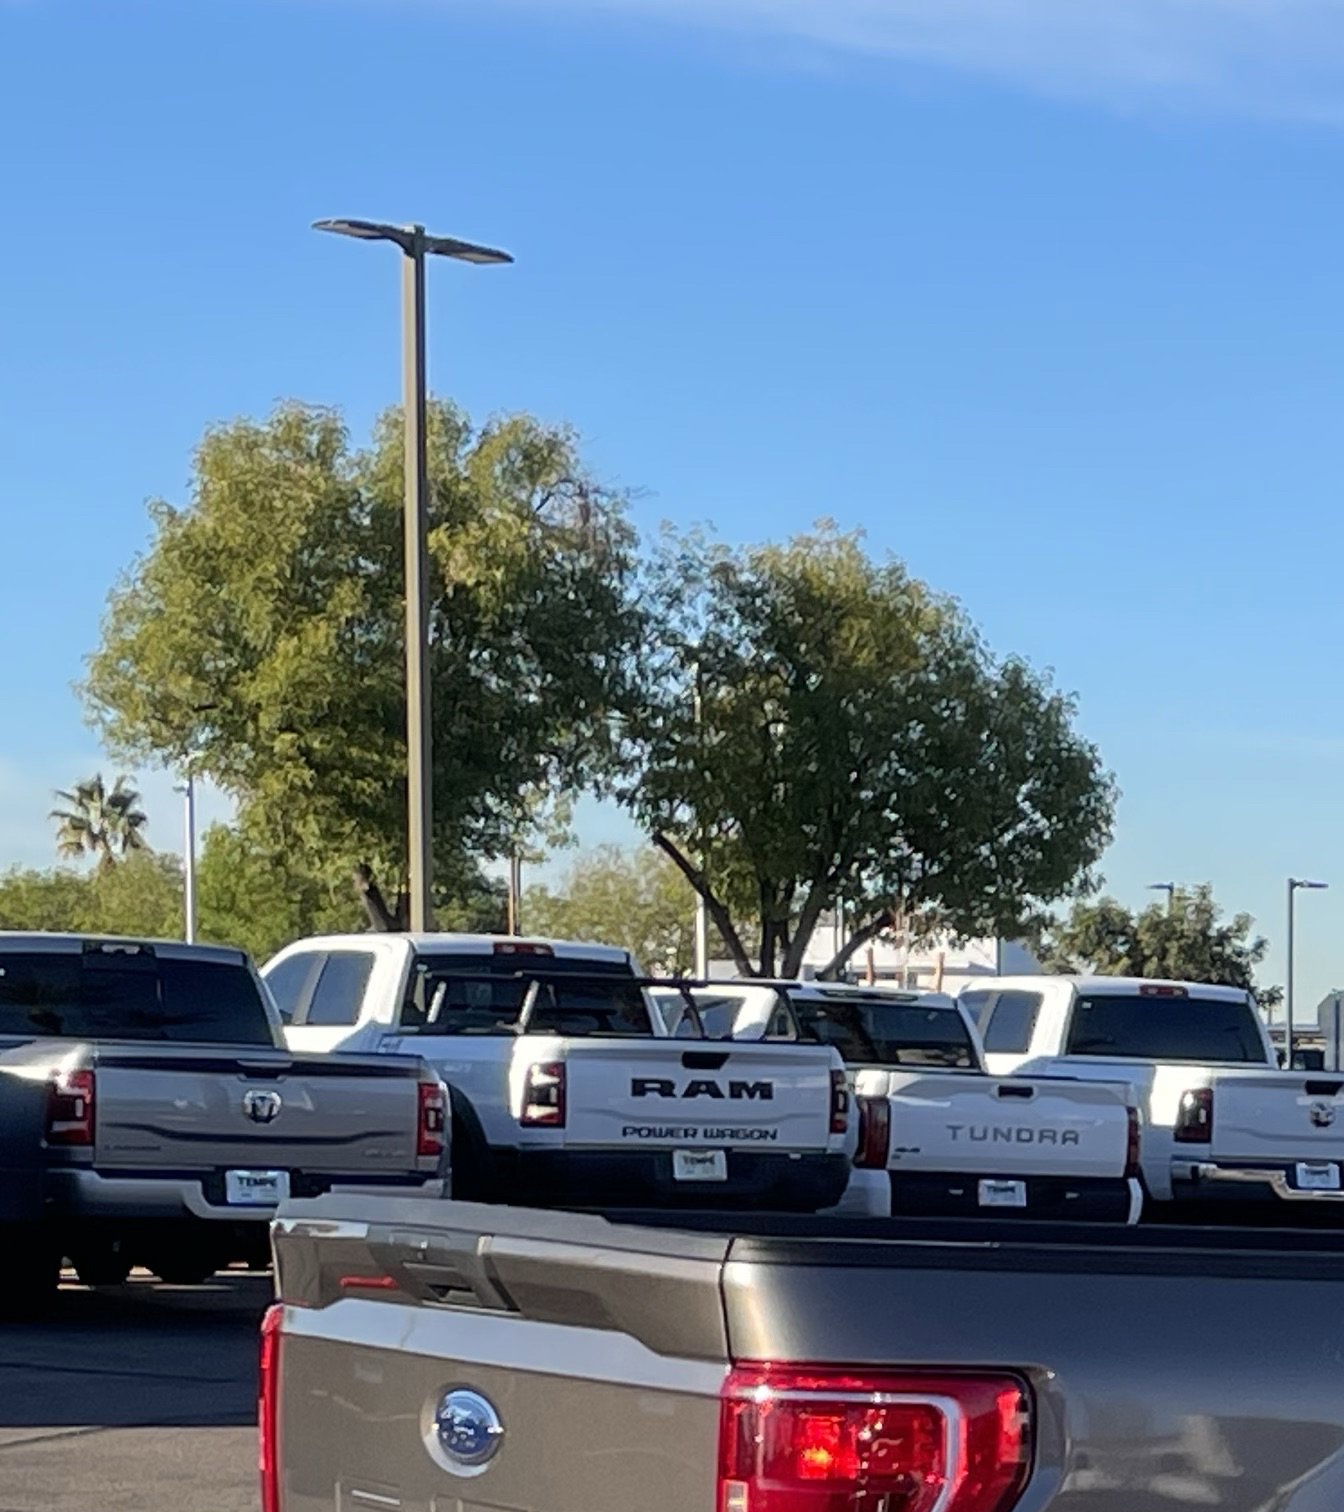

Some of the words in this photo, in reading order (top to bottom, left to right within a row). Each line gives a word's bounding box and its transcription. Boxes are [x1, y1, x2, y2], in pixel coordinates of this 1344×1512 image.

[630, 1078, 774, 1100] RAM
[622, 1126, 699, 1139] POWER
[703, 1128, 778, 1141] WAGON
[946, 1125, 1080, 1146] TUNDRA
